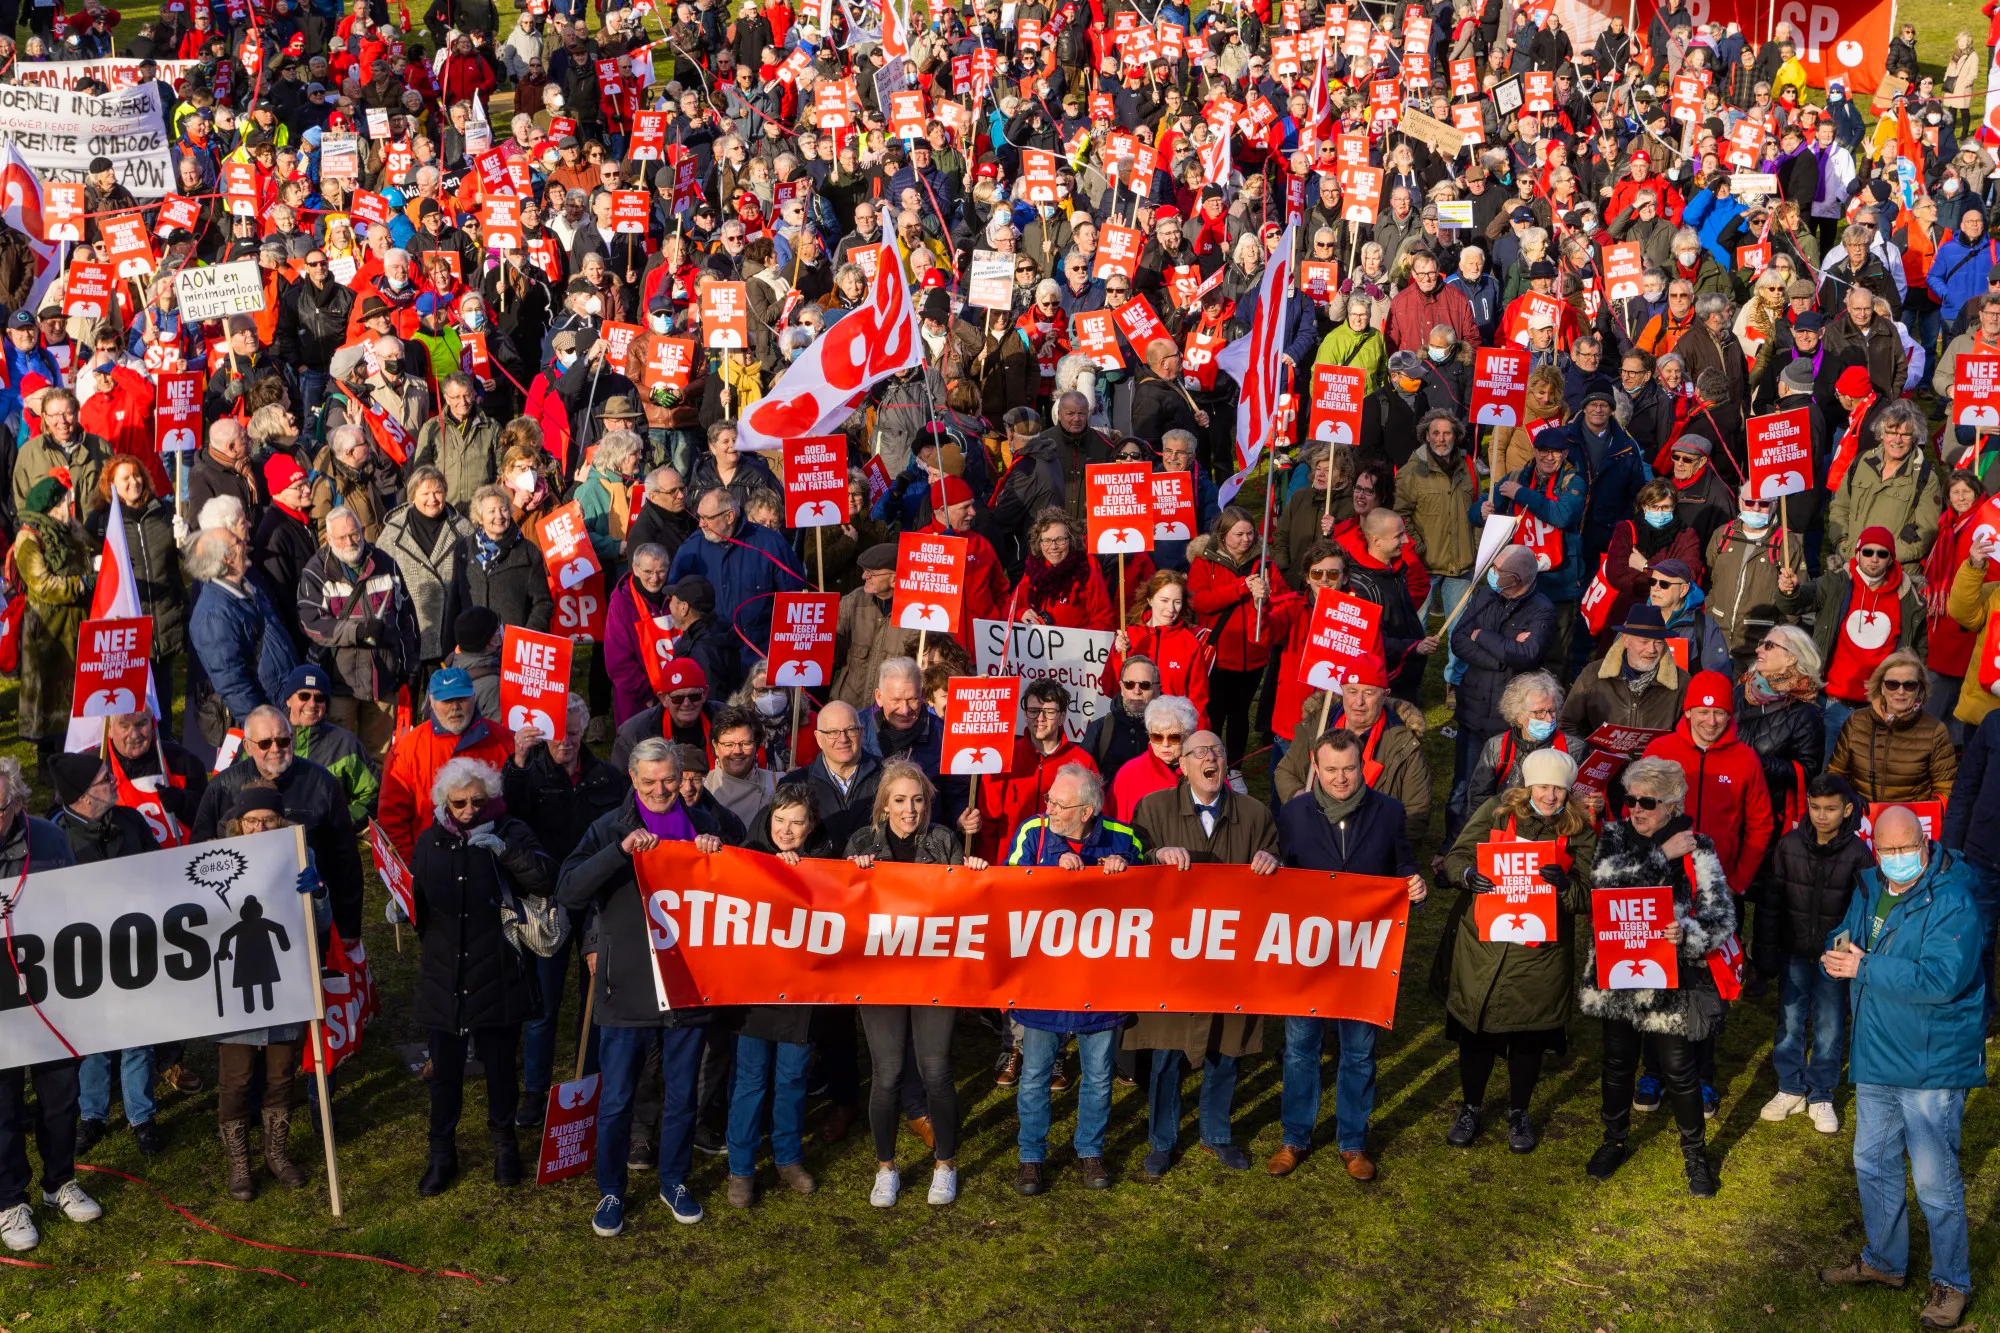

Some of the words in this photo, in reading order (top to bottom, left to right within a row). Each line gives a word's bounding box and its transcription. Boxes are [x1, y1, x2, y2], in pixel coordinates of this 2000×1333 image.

[1781, 2, 1839, 63] SP
[600, 63, 614, 72] NEE
[1408, 58, 1424, 66] NEE
[1454, 62, 1470, 72] NEE
[1531, 76, 1547, 85] NEE
[1680, 82, 1698, 93] NEE
[1376, 84, 1394, 95] NEE
[640, 116, 661, 128] NEE
[1739, 126, 1758, 138] NEE
[88, 132, 160, 155] OMHOOG
[1112, 137, 1131, 148] NEE
[1344, 140, 1362, 153] NEE
[482, 154, 500, 172] NEE
[1138, 149, 1152, 164] NEE
[122, 159, 166, 188] AOW
[680, 163, 693, 177] NEE
[1353, 172, 1375, 186] NEE
[1107, 231, 1132, 246] NEE
[182, 269, 215, 291] AOW
[224, 272, 238, 282] en
[1309, 267, 1330, 280] NEE
[184, 284, 261, 302] minimumloon
[711, 289, 737, 303] NEE
[188, 302, 225, 319] BLIJFT
[234, 295, 261, 312] EEN
[1530, 298, 1556, 314] NEE
[1122, 302, 1147, 327] NEE
[1083, 317, 1106, 333] NEE
[608, 328, 634, 344] NEE
[145, 345, 179, 370] SP
[657, 343, 684, 360] NEE
[1182, 348, 1211, 371] SP
[1486, 356, 1519, 375] NEE
[1966, 362, 1998, 378] NEE
[1320, 373, 1358, 385] INDEXATIE
[1476, 380, 1524, 390] ONTKOPPELING
[1492, 374, 1512, 382] TEGEN
[167, 380, 194, 399] NEE
[1328, 383, 1348, 393] VOOR
[1492, 388, 1508, 396] AOW
[1957, 384, 2000, 392] ONTKOPPELIN
[1324, 391, 1351, 402] IEDERE
[159, 405, 200, 415] ONTKOPPELING
[1316, 400, 1357, 412] GENERATIE
[174, 413, 187, 421] AOW
[1768, 420, 1790, 431] GOED
[1759, 426, 1800, 441] PENSIOEN
[805, 445, 826, 454] GOED
[1762, 443, 1798, 457] KWESTIE
[795, 453, 836, 464] PENSIOEN
[1754, 457, 1770, 466] VAN
[1773, 449, 1807, 464] FATSOEN
[798, 471, 834, 482] KWESTIE
[1094, 473, 1144, 484] INDEXATIE
[790, 482, 807, 492] VAN
[809, 479, 843, 490] FATSOEN
[1107, 484, 1132, 495] VOOR
[1152, 480, 1181, 496] NEE
[1103, 494, 1136, 505] IEDERE
[1153, 501, 1191, 509] TKOPPELING
[1094, 504, 1146, 516] GENERATIE
[545, 513, 573, 541] NEE
[1524, 516, 1554, 547] SP
[546, 532, 585, 558] ONTKOPPELING
[554, 531, 571, 545] TEGEN
[561, 546, 574, 558] AOW
[921, 543, 944, 553] GOED
[909, 552, 954, 565] PENSIOEN
[910, 571, 949, 583] KWESTIE
[900, 580, 917, 590] VAN
[920, 583, 957, 594] FATSOEN
[559, 595, 597, 628] SP
[787, 603, 825, 624] NEE
[1338, 602, 1361, 617] GOED
[1325, 608, 1368, 630] PENSIOEN
[793, 625, 816, 633] TEGEN
[94, 628, 137, 653] NEE
[775, 633, 832, 642] ONTKOPPELING
[988, 625, 1063, 660] STOP
[1084, 638, 1108, 664] de
[1324, 628, 1361, 648] KWESTIE
[793, 642, 812, 650] AOW
[1313, 635, 1330, 648] VAN
[1332, 641, 1367, 657] FATSOE
[101, 651, 128, 662] TEGEN
[515, 639, 556, 671] NEE
[81, 657, 145, 672] ONTKOPPELING
[103, 669, 123, 680] AOW
[521, 665, 546, 680] TEGEN
[504, 670, 564, 693] ONTKOPPELING
[522, 685, 541, 698] AOW
[956, 689, 1011, 700] INDEXATIE
[969, 700, 996, 711] VOOR
[963, 711, 1000, 722] IEDERE
[952, 723, 1009, 734] GENERATIE
[1609, 730, 1652, 742] NEE
[200, 859, 234, 875] @#&$!
[1493, 853, 1539, 876] NEE
[1502, 876, 1531, 885] TEGEN
[1506, 894, 1528, 903] AOW
[1609, 898, 1656, 921] NEE
[648, 889, 845, 955] STRIJD
[864, 913, 989, 961] MEE
[1008, 908, 1154, 960] VOOR
[1171, 909, 1241, 962] JE
[1255, 912, 1393, 970] AOW
[1619, 922, 1649, 930] TEGEN
[1599, 930, 1665, 941] ONTKOPPELIN
[1624, 939, 1646, 949] AOW
[0, 903, 212, 1011] BOOS
[549, 1115, 594, 1138] GENERATIE
[556, 1130, 585, 1147] IEDERE
[559, 1143, 580, 1158] VOOR
[546, 1150, 588, 1173] INDEXATIE
